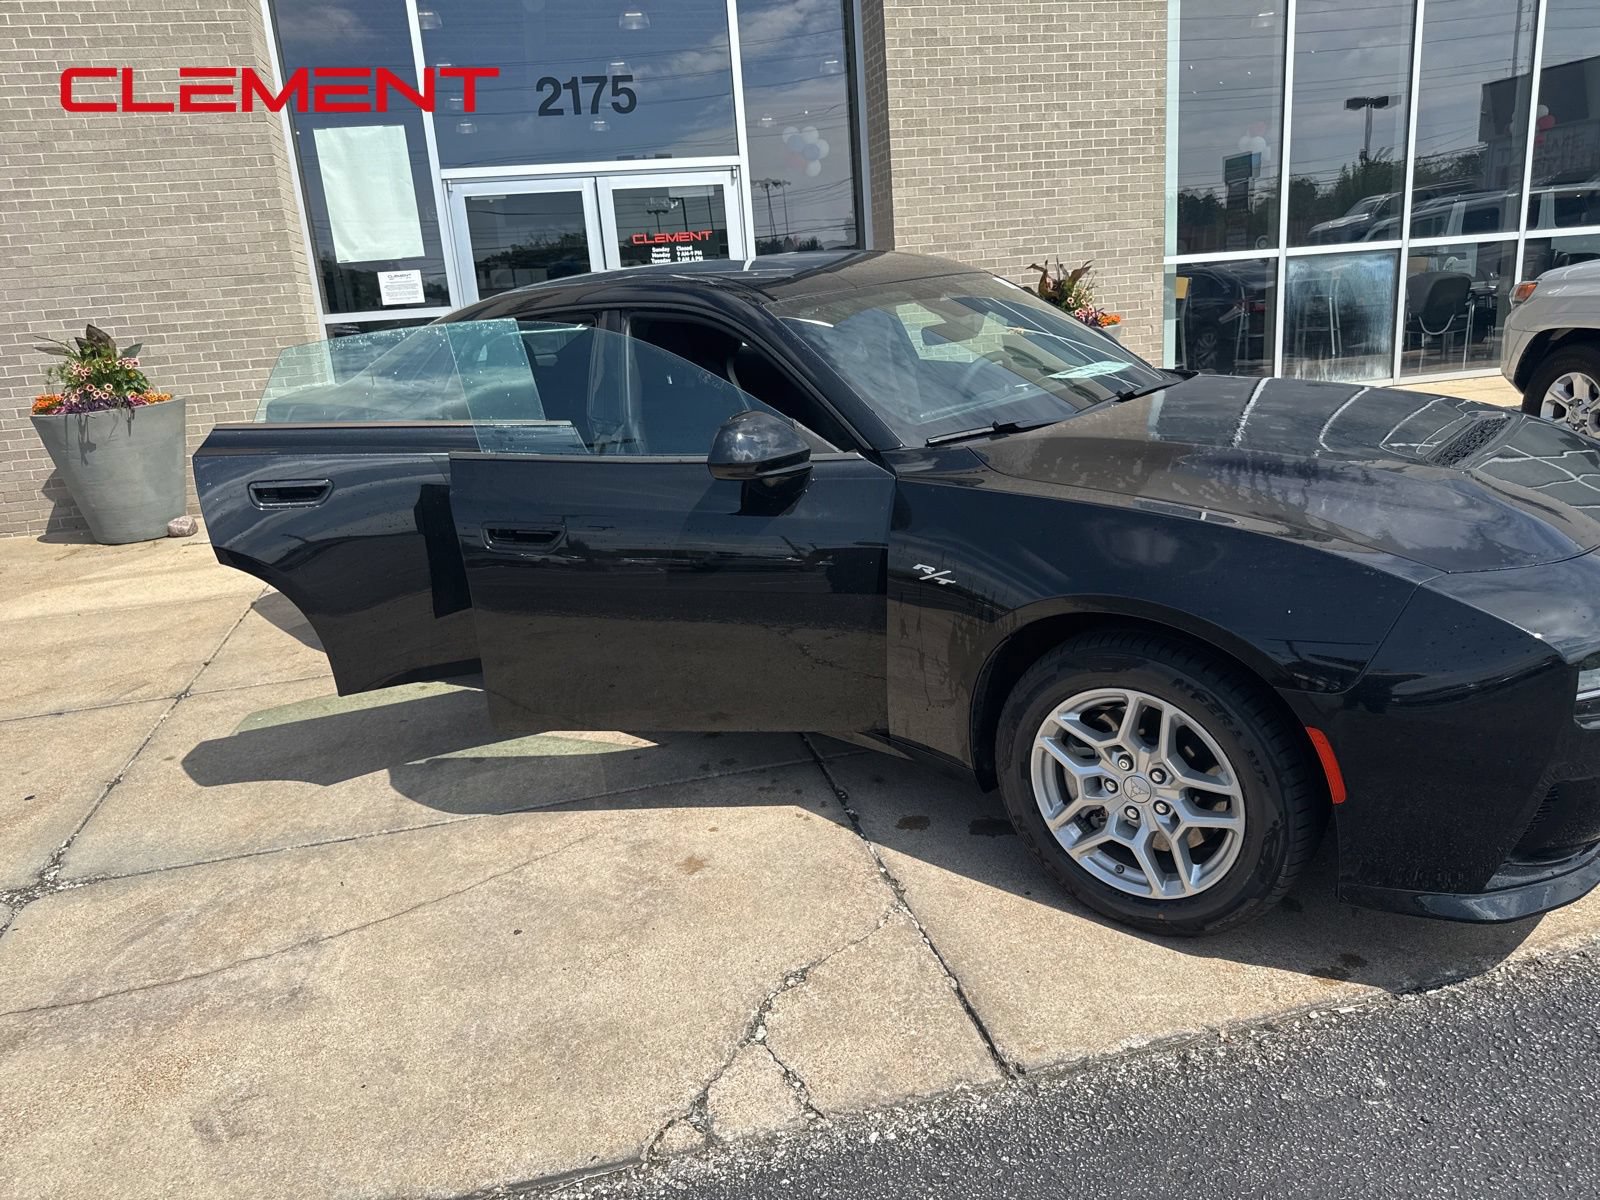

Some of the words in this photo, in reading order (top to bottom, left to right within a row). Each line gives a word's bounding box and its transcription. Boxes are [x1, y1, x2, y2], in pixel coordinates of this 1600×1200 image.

[536, 74, 637, 117] 2175
[632, 231, 712, 244] CLEMENT
[912, 563, 957, 585] R/T
